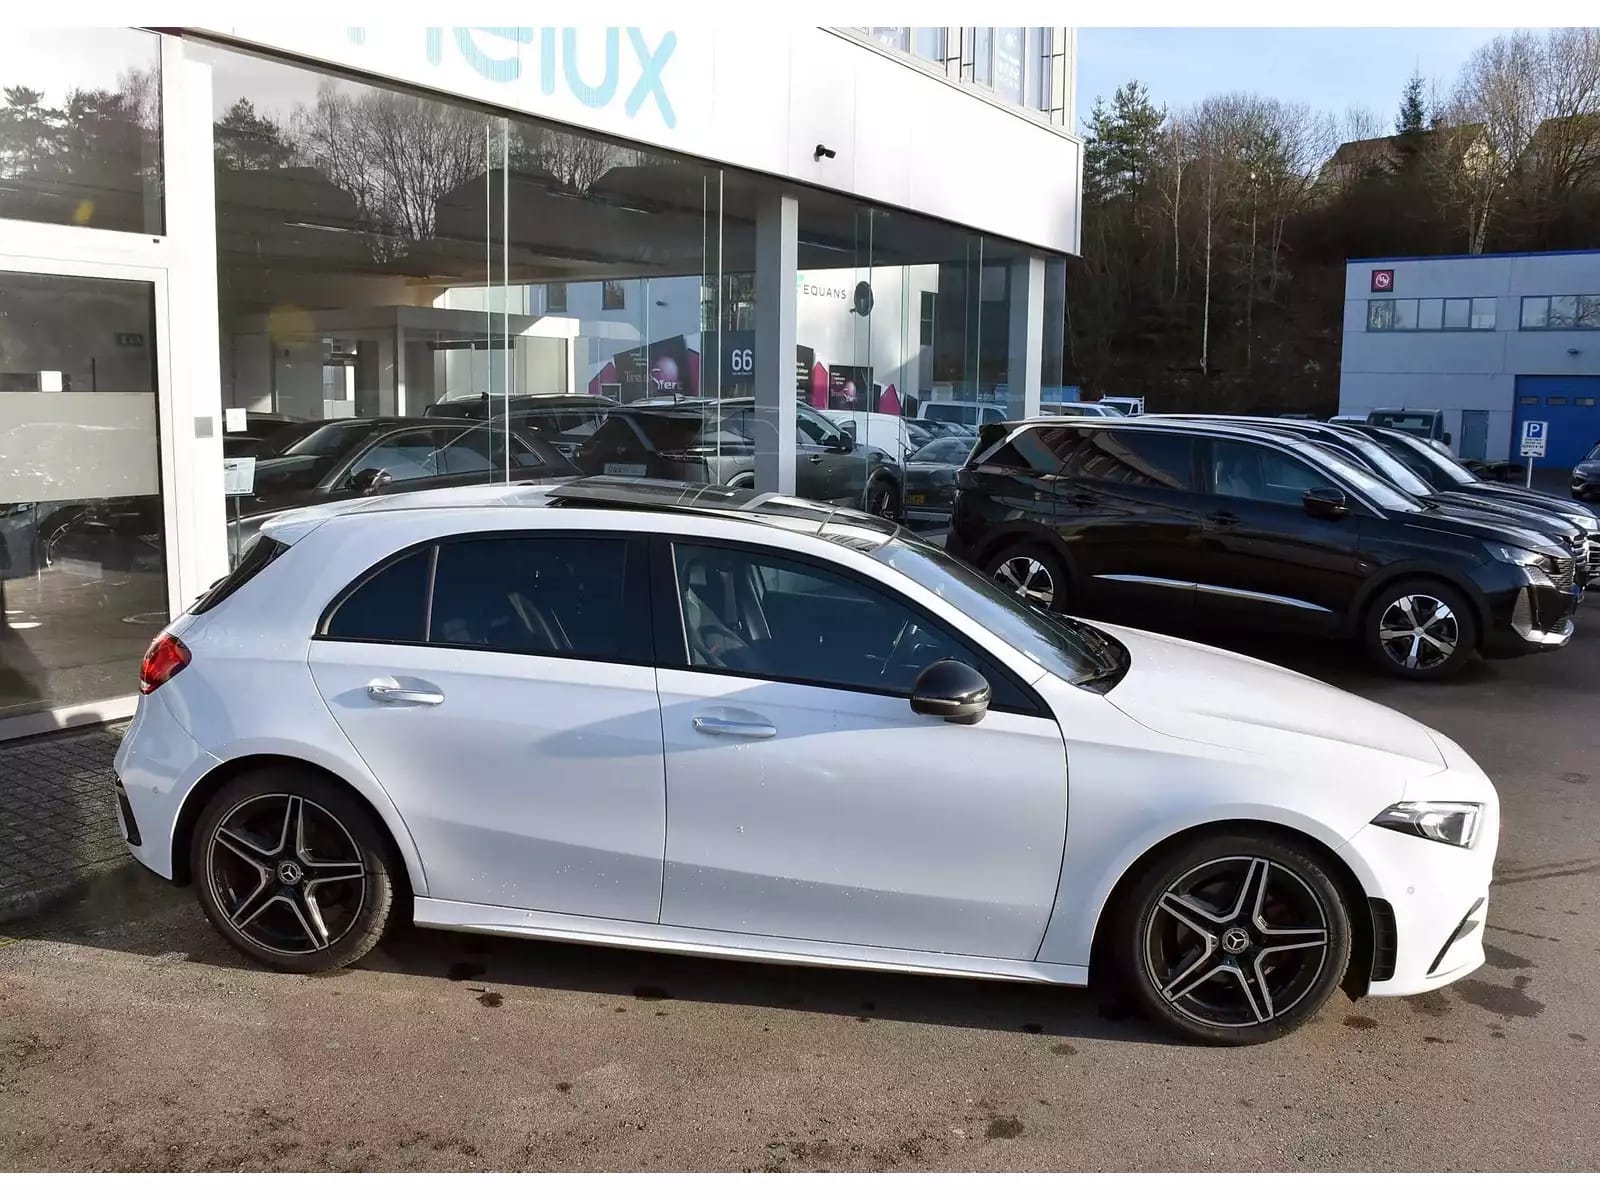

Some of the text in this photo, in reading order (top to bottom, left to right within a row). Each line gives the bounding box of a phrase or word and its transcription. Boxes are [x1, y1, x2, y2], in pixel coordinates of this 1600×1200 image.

[803, 284, 847, 300] EQUANS
[731, 349, 752, 371] 66
[1529, 423, 1541, 437] P
